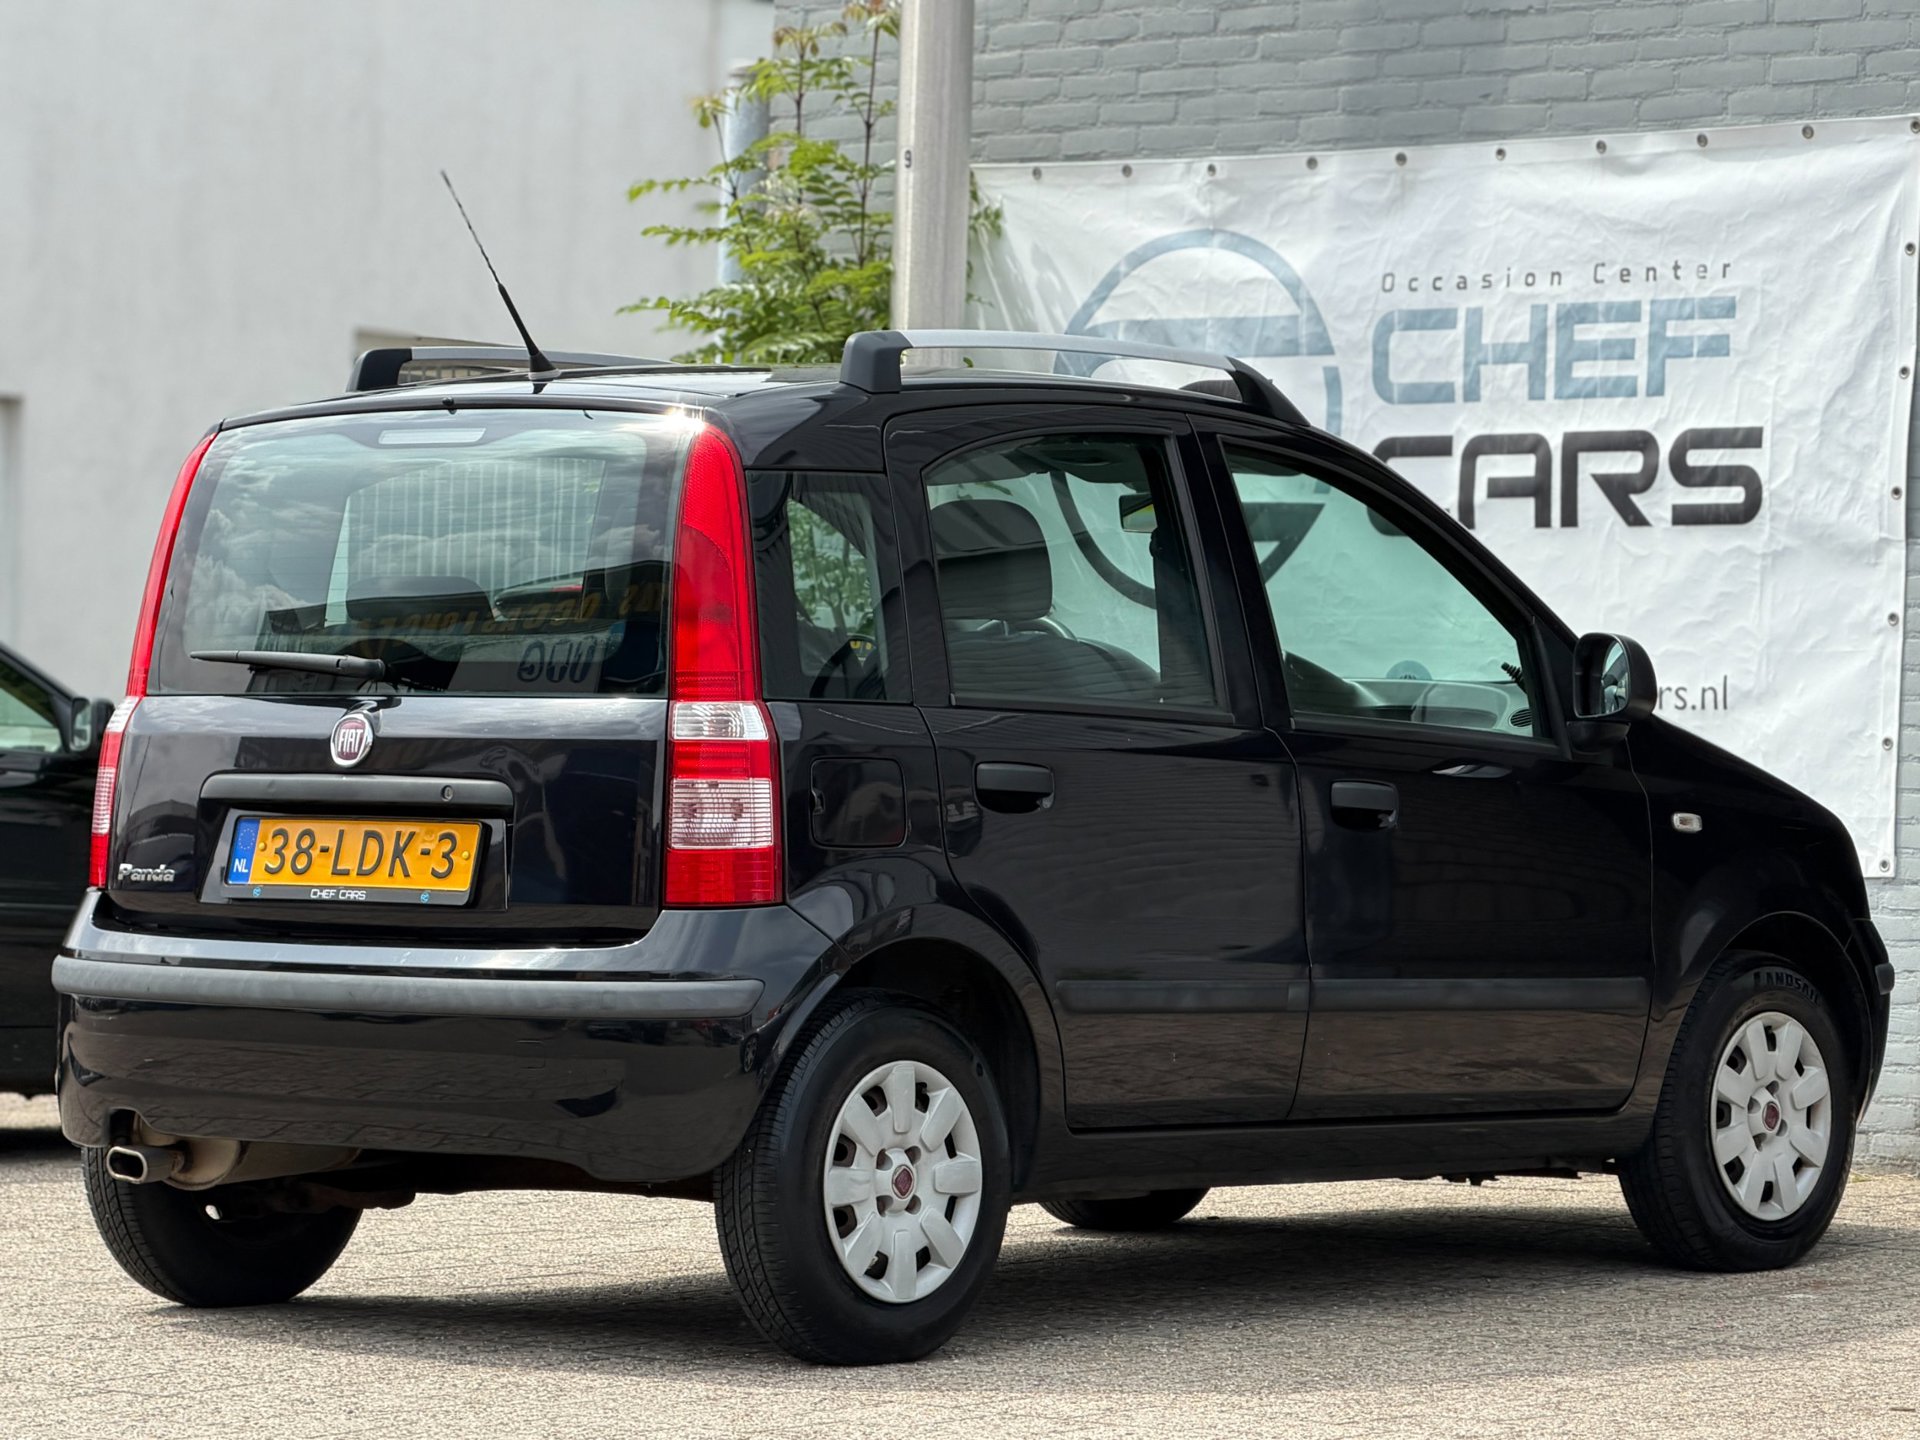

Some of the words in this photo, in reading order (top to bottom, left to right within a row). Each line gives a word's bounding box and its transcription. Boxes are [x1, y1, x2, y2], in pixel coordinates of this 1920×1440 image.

[1381, 267, 1563, 293] Occasion
[1593, 259, 1732, 284] Center
[1372, 295, 1736, 405] CHEF
[1367, 426, 1764, 536] CARS
[1656, 674, 1728, 710] rs.nl
[337, 728, 364, 753] FIAT
[233, 858, 249, 874] NL
[263, 827, 458, 880] 38-LDK-3
[117, 862, 176, 882] Panda
[310, 888, 336, 899] CHEF
[338, 889, 366, 900] CARS
